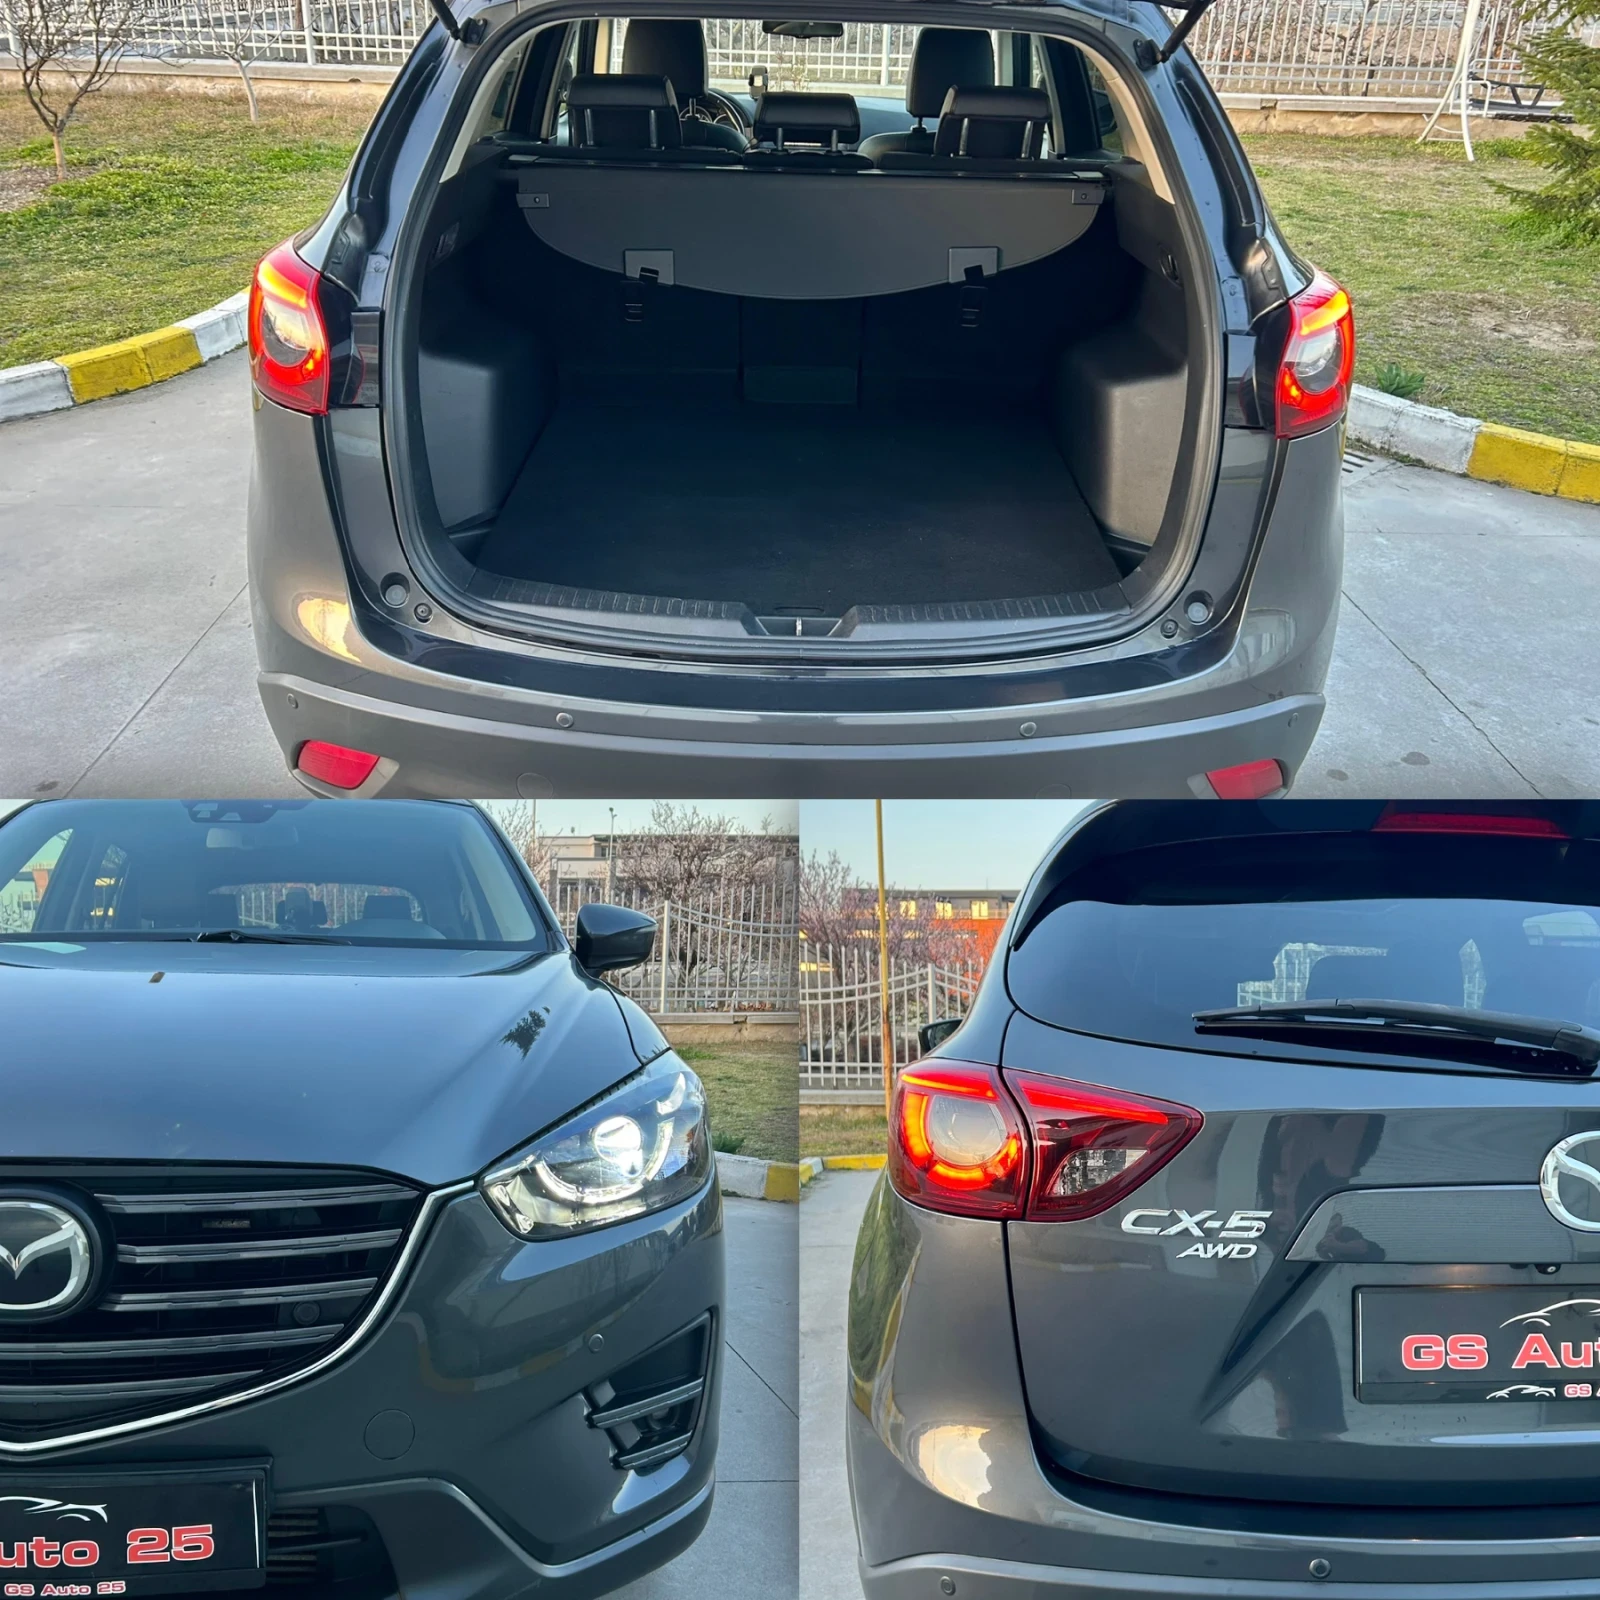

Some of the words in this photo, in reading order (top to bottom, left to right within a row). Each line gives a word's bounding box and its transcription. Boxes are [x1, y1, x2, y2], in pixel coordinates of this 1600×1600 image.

[1121, 1208, 1273, 1238] CX-5
[1176, 1243, 1257, 1259] AWD
[1402, 1334, 1489, 1371] GS
[1511, 1333, 1600, 1369] Au
[1564, 1384, 1592, 1398] GS
[126, 1524, 214, 1564] 25
[4, 1584, 35, 1596] GS
[40, 1584, 91, 1596] Auto
[97, 1581, 126, 1594] 25
